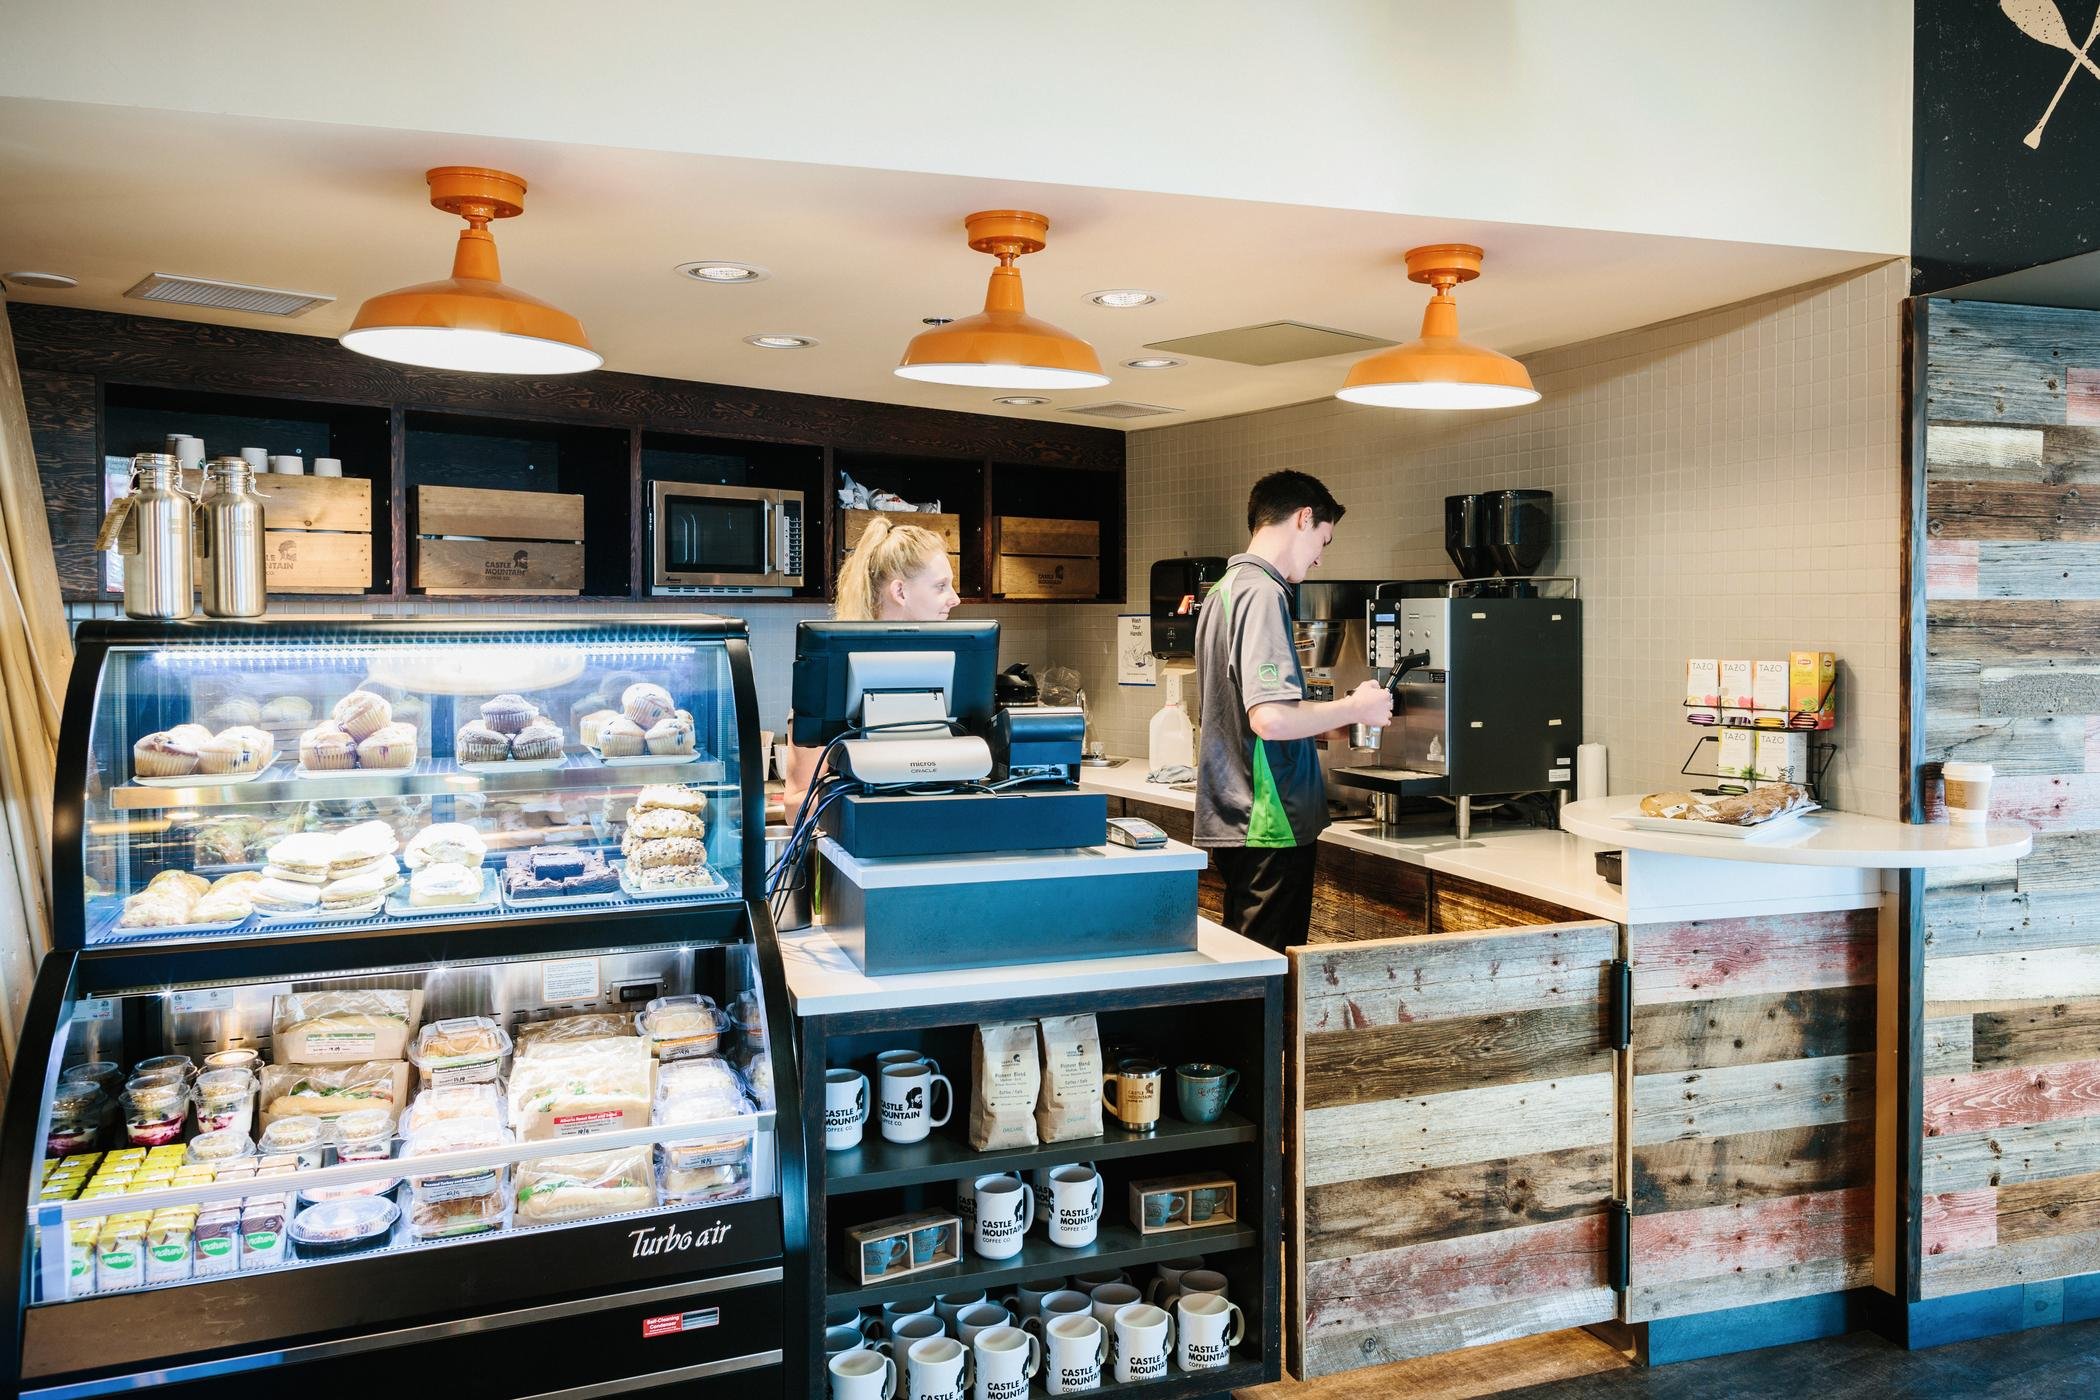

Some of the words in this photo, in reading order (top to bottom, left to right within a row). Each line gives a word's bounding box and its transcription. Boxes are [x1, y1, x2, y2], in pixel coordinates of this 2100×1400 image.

[484, 561, 513, 569] CASTLE
[1692, 662, 1714, 671] TAZO
[1724, 663, 1747, 672] TAZO
[1759, 664, 1782, 673] TAZO
[1724, 732, 1747, 741] TAZO
[1761, 735, 1785, 744] TAZO
[1060, 1208, 1089, 1217] CASTLE
[982, 1220, 1012, 1229] CASTLE
[628, 1223, 693, 1258] Turbo
[695, 1219, 732, 1247] air
[1188, 1343, 1219, 1353] CASTLE
[1130, 1355, 1161, 1365] CASTLE
[1061, 1366, 1093, 1377] CASTLE
[1130, 1361, 1167, 1374] MOUNTA
[1061, 1371, 1100, 1386] MOUNTA
[987, 1380, 1021, 1391] CASTLE
